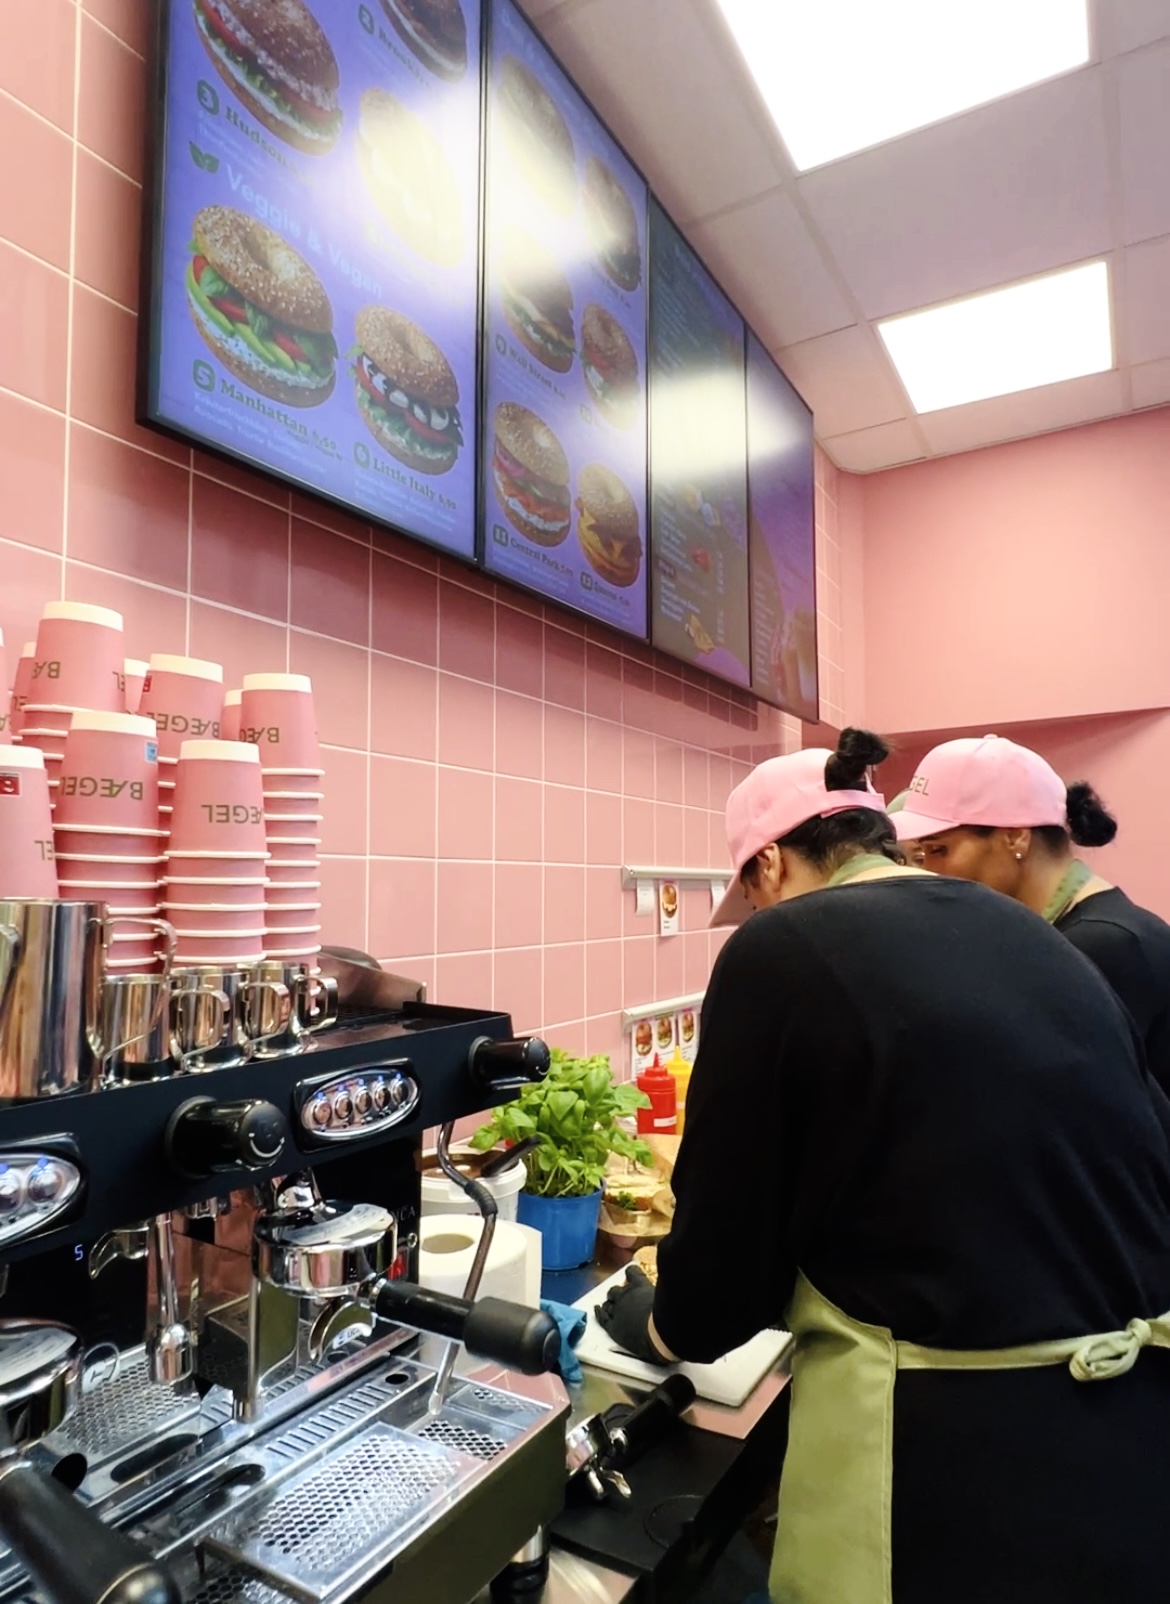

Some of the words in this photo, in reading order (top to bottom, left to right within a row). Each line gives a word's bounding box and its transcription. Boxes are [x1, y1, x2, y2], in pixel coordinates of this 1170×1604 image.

[225, 105, 287, 167] Hudson
[226, 164, 302, 241] Veggie
[307, 226, 325, 255] &
[327, 241, 383, 299] Vegan
[220, 378, 309, 439] Manhattan
[372, 457, 407, 486] Little
[409, 476, 436, 502] Italy
